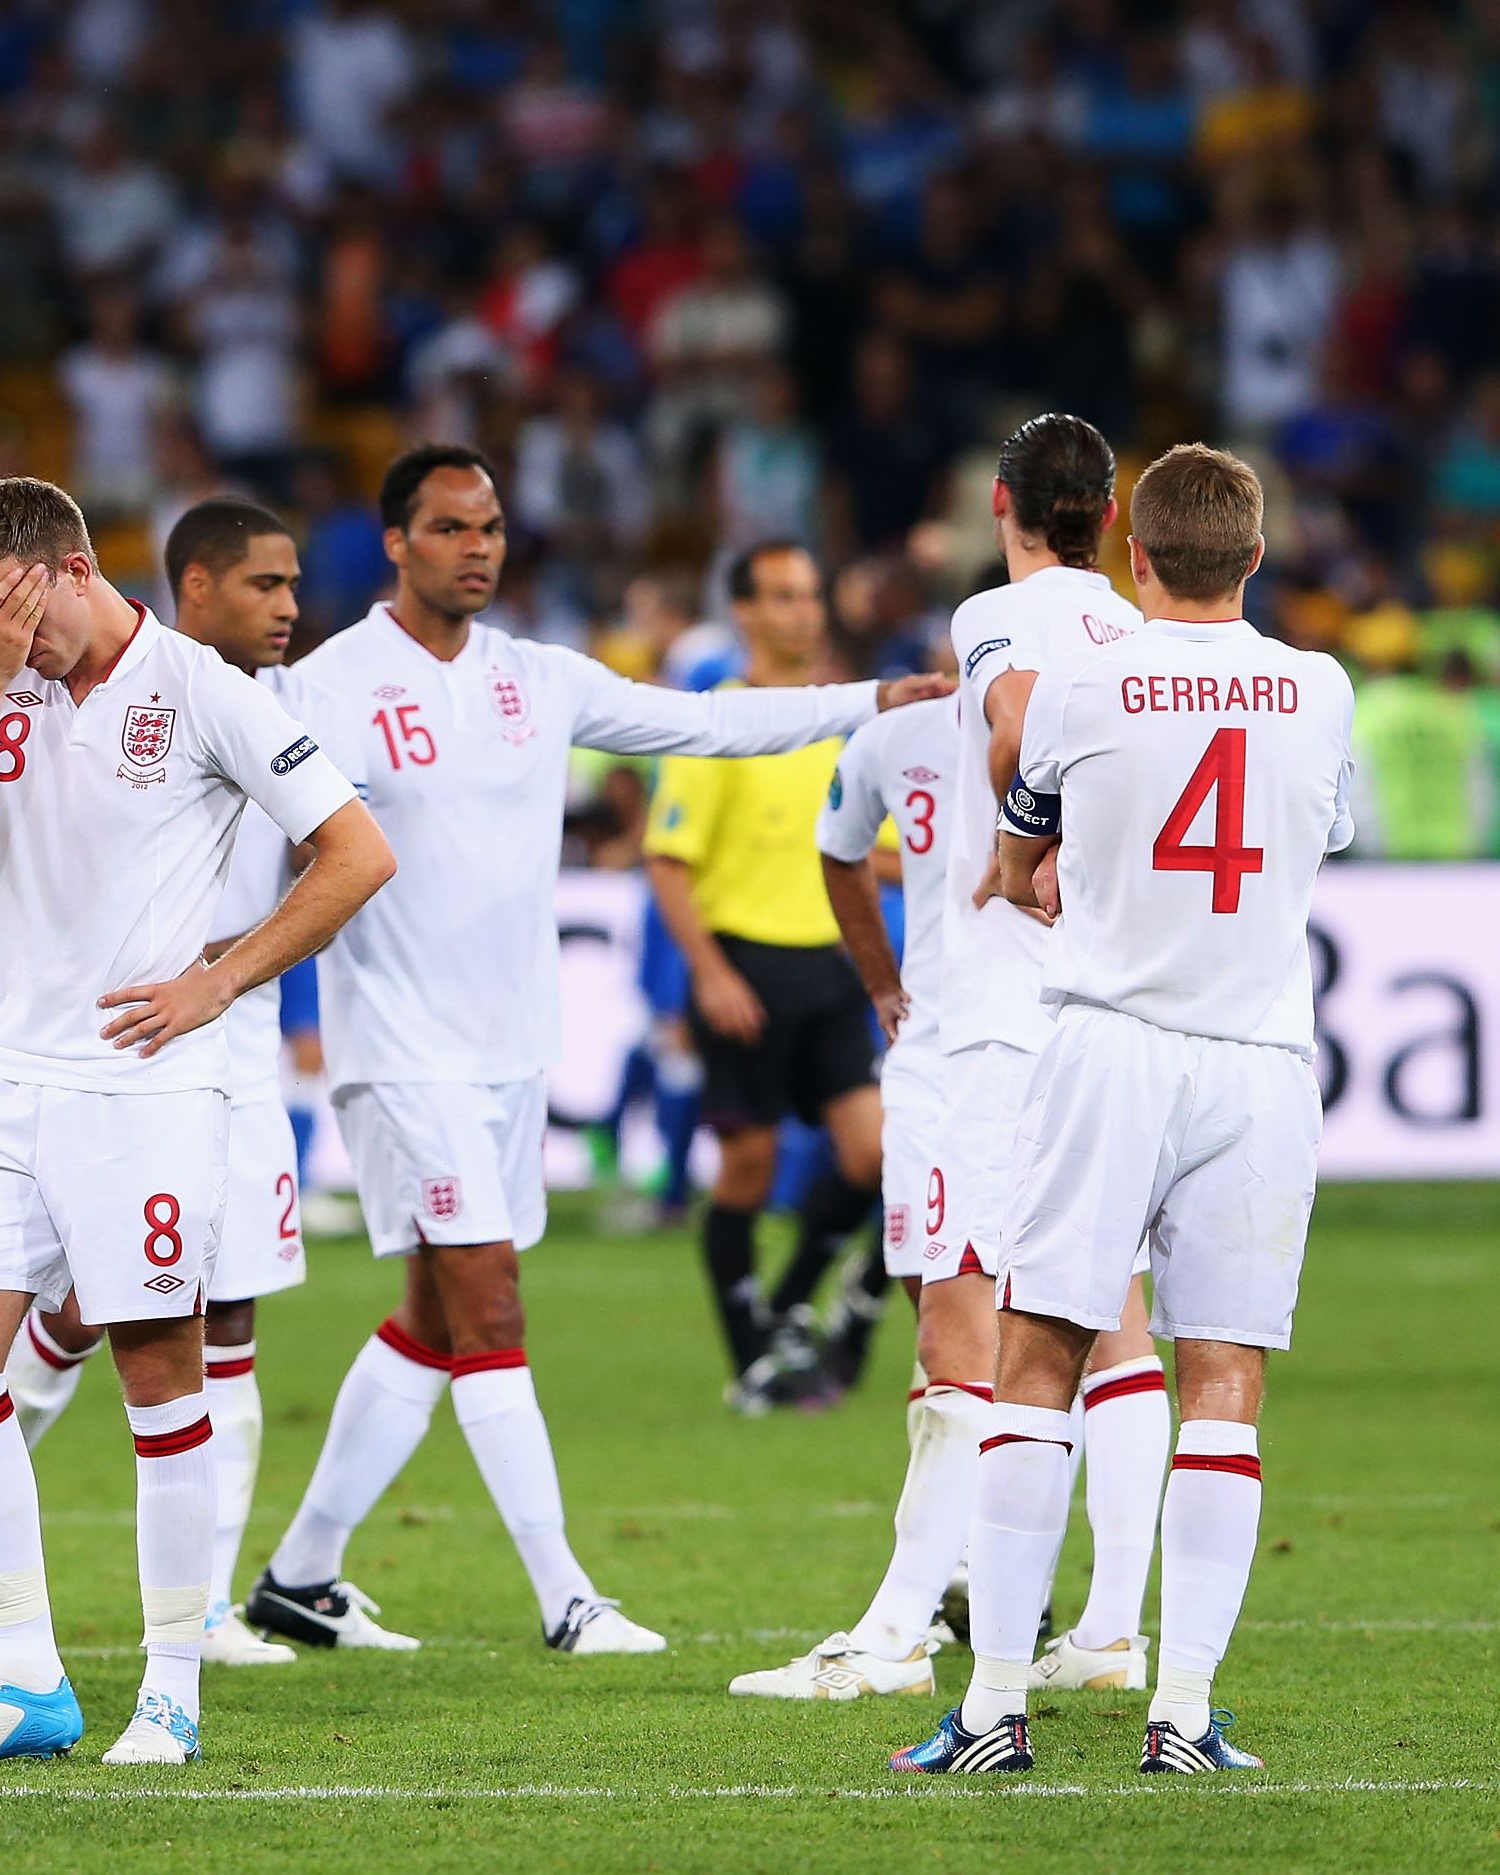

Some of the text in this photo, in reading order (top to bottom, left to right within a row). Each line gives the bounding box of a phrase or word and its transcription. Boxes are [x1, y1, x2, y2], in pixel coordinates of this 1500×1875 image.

[968, 638, 1009, 664] RESPECT
[1121, 675, 1299, 715] GERRARD
[286, 738, 317, 762] RESP
[372, 704, 437, 771] 15
[131, 782, 149, 791] 2012
[897, 789, 937, 861] 3
[1151, 727, 1264, 915] 4
[144, 1192, 183, 1268] 8
[275, 1171, 298, 1240] 2
[925, 1166, 946, 1236] 9
